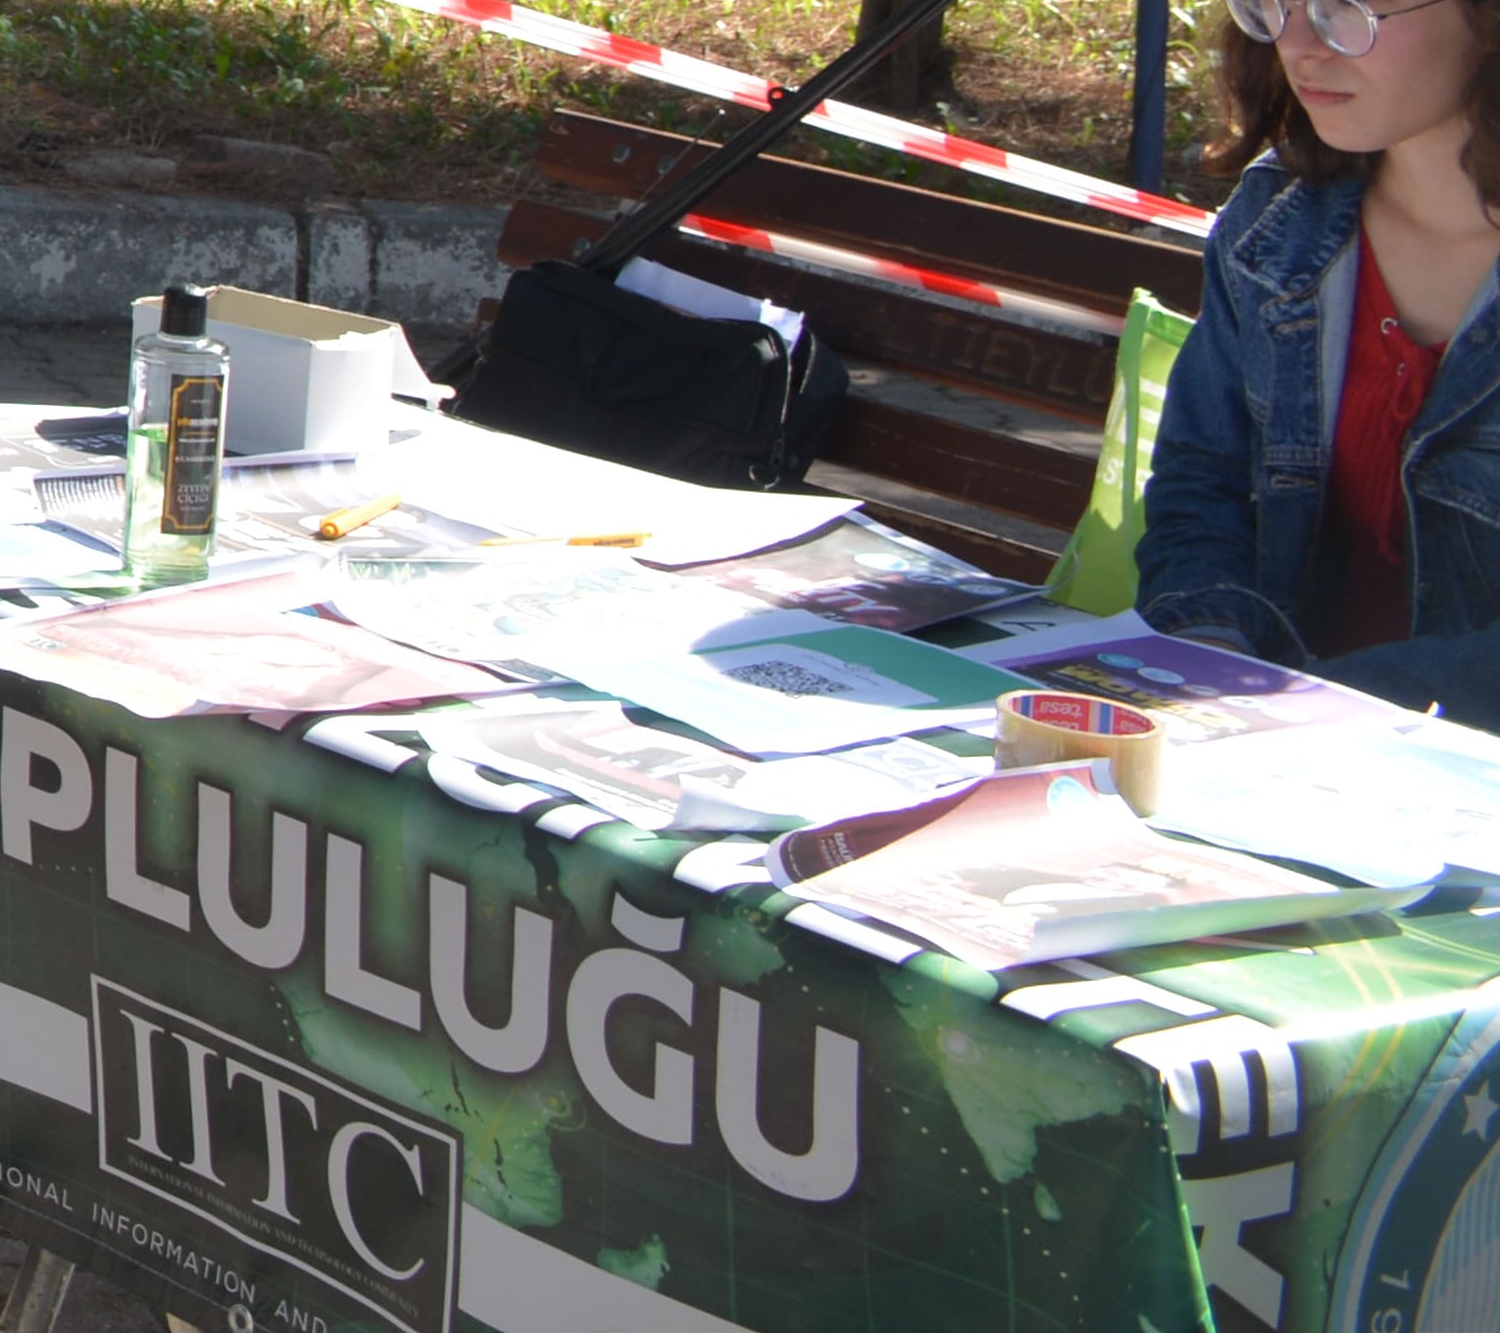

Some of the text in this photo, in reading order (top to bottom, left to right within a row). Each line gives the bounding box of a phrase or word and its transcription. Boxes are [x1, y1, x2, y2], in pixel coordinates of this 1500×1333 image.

[1040, 700, 1083, 718] tesa
[119, 1008, 425, 1281] IITC
[91, 1202, 257, 1304] INFORMATION
[273, 1298, 329, 1333] AND
